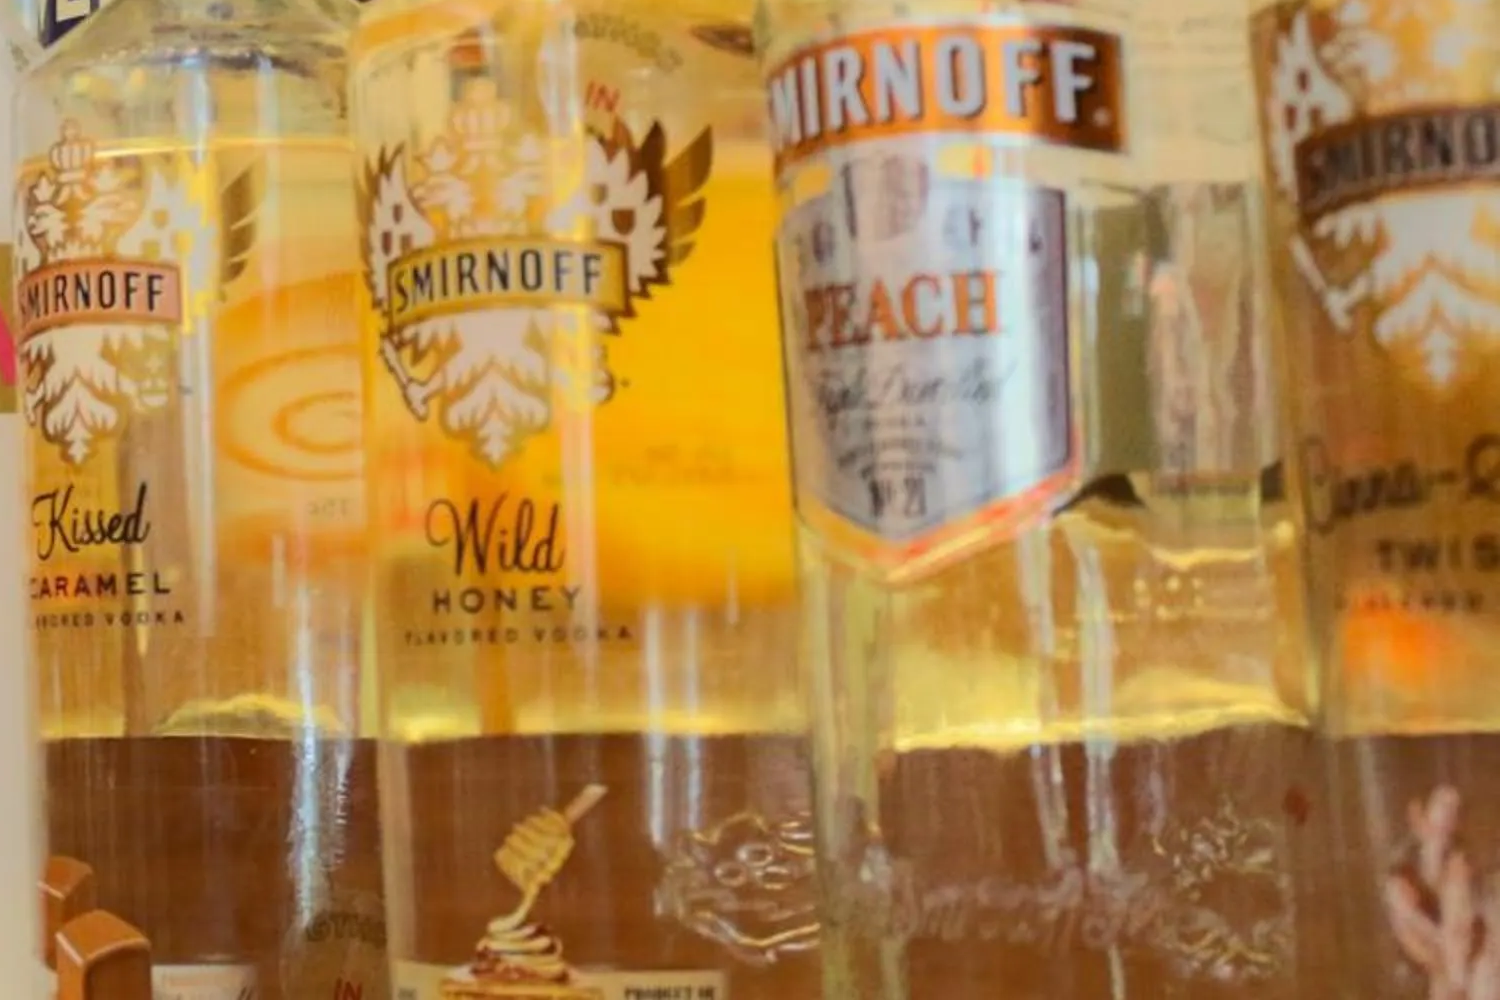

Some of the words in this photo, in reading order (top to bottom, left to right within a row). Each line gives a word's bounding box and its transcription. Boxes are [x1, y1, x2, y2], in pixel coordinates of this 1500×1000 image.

[769, 34, 1097, 150] MIRNOFF
[395, 248, 603, 315] SMIRNOFF
[804, 269, 1000, 351] PEACH
[31, 480, 151, 561] Kissed
[425, 490, 565, 577] Wild
[105, 611, 184, 628] VODKA
[404, 625, 519, 646] FLAVORED
[533, 623, 632, 643] VODKA
[432, 584, 581, 615] HONEY
